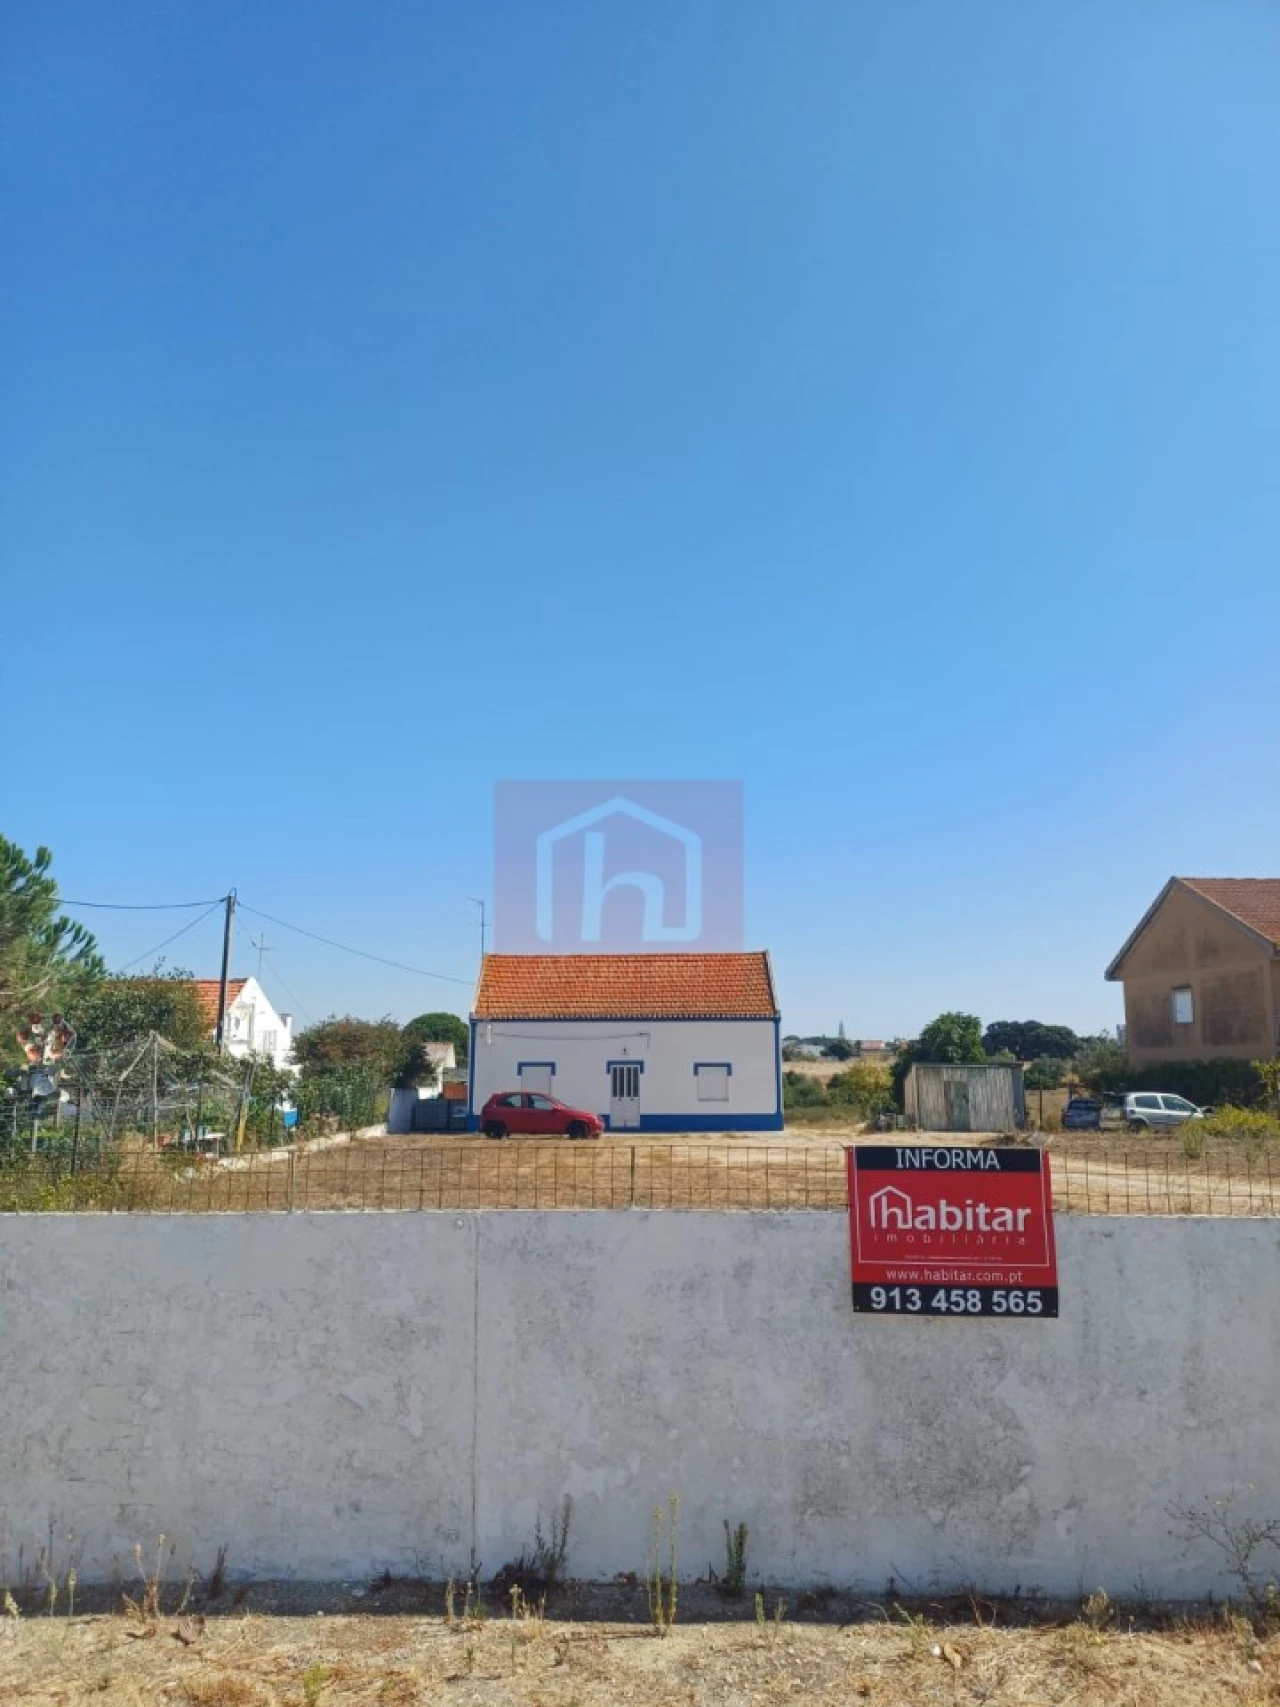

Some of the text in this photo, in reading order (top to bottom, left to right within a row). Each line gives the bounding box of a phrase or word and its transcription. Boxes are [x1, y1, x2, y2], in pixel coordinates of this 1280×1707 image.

[895, 1149, 1000, 1170] INFORMA
[869, 1185, 1031, 1232] habitar
[886, 1269, 1023, 1284] www.habitar.com.pt
[870, 1286, 1042, 1314] 913 458 565
